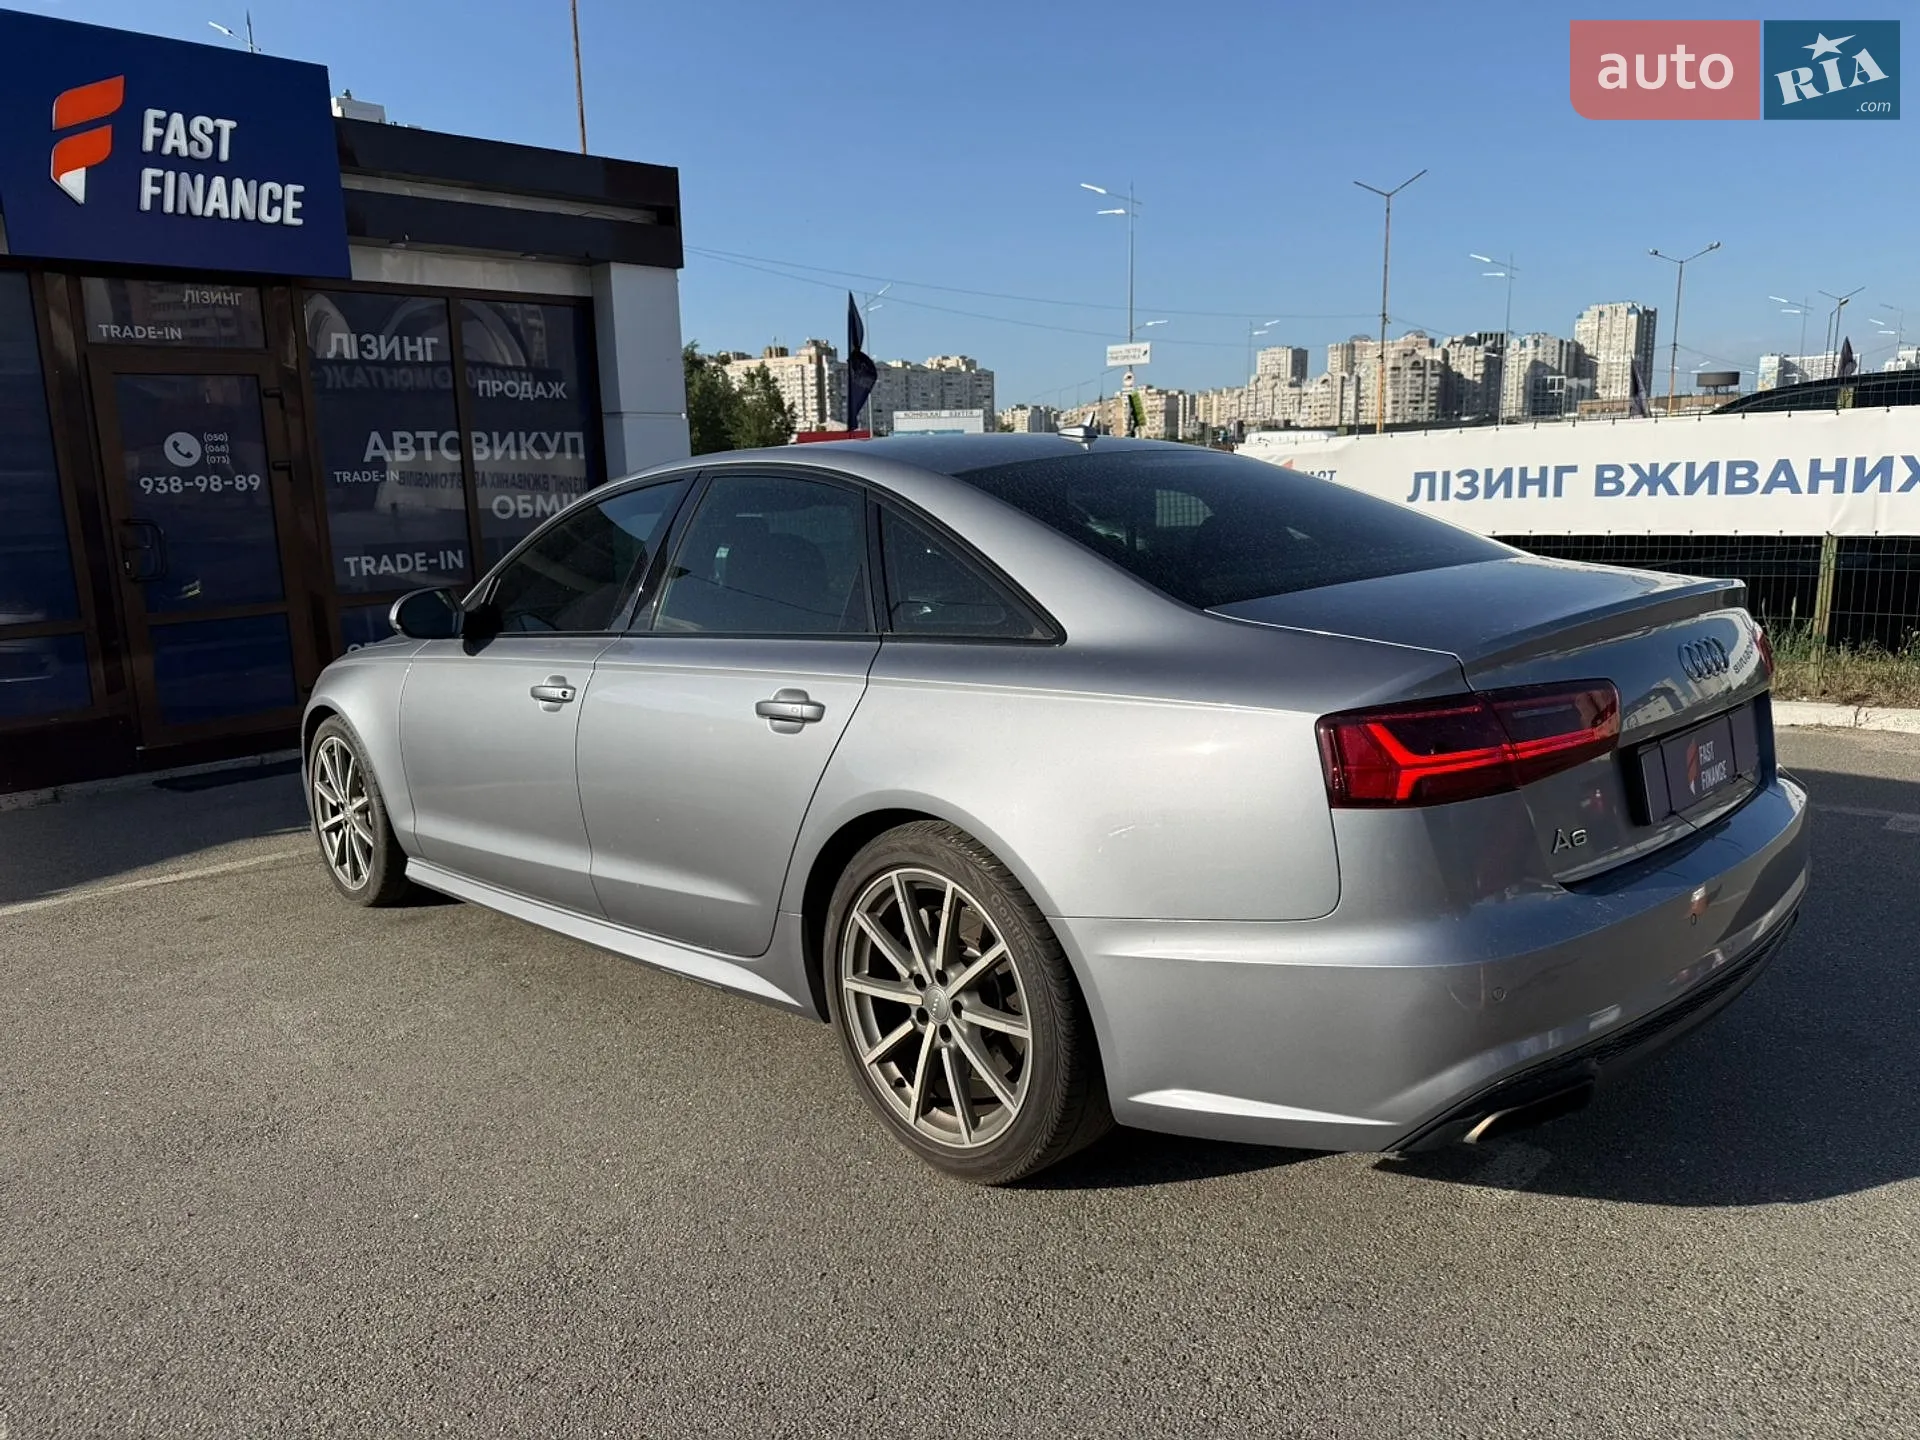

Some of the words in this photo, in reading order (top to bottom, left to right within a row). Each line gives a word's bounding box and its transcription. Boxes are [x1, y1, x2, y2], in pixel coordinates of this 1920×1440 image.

[142, 108, 237, 162] FAST
[140, 167, 304, 225] FINANCE
[183, 289, 243, 306] ЛІЗИНГ
[98, 324, 182, 340] TRADE-IN
[327, 332, 439, 362] ЛІЗИНГ
[477, 379, 568, 400] ПРОДАЖ
[139, 474, 261, 494] 938-98-89
[333, 470, 400, 483] TRADE-IN
[1407, 464, 1577, 503] ЛІЗИНГ
[492, 493, 576, 519] ОБМ
[343, 550, 465, 577] TRADE-IN
[1551, 828, 1588, 855] A6
